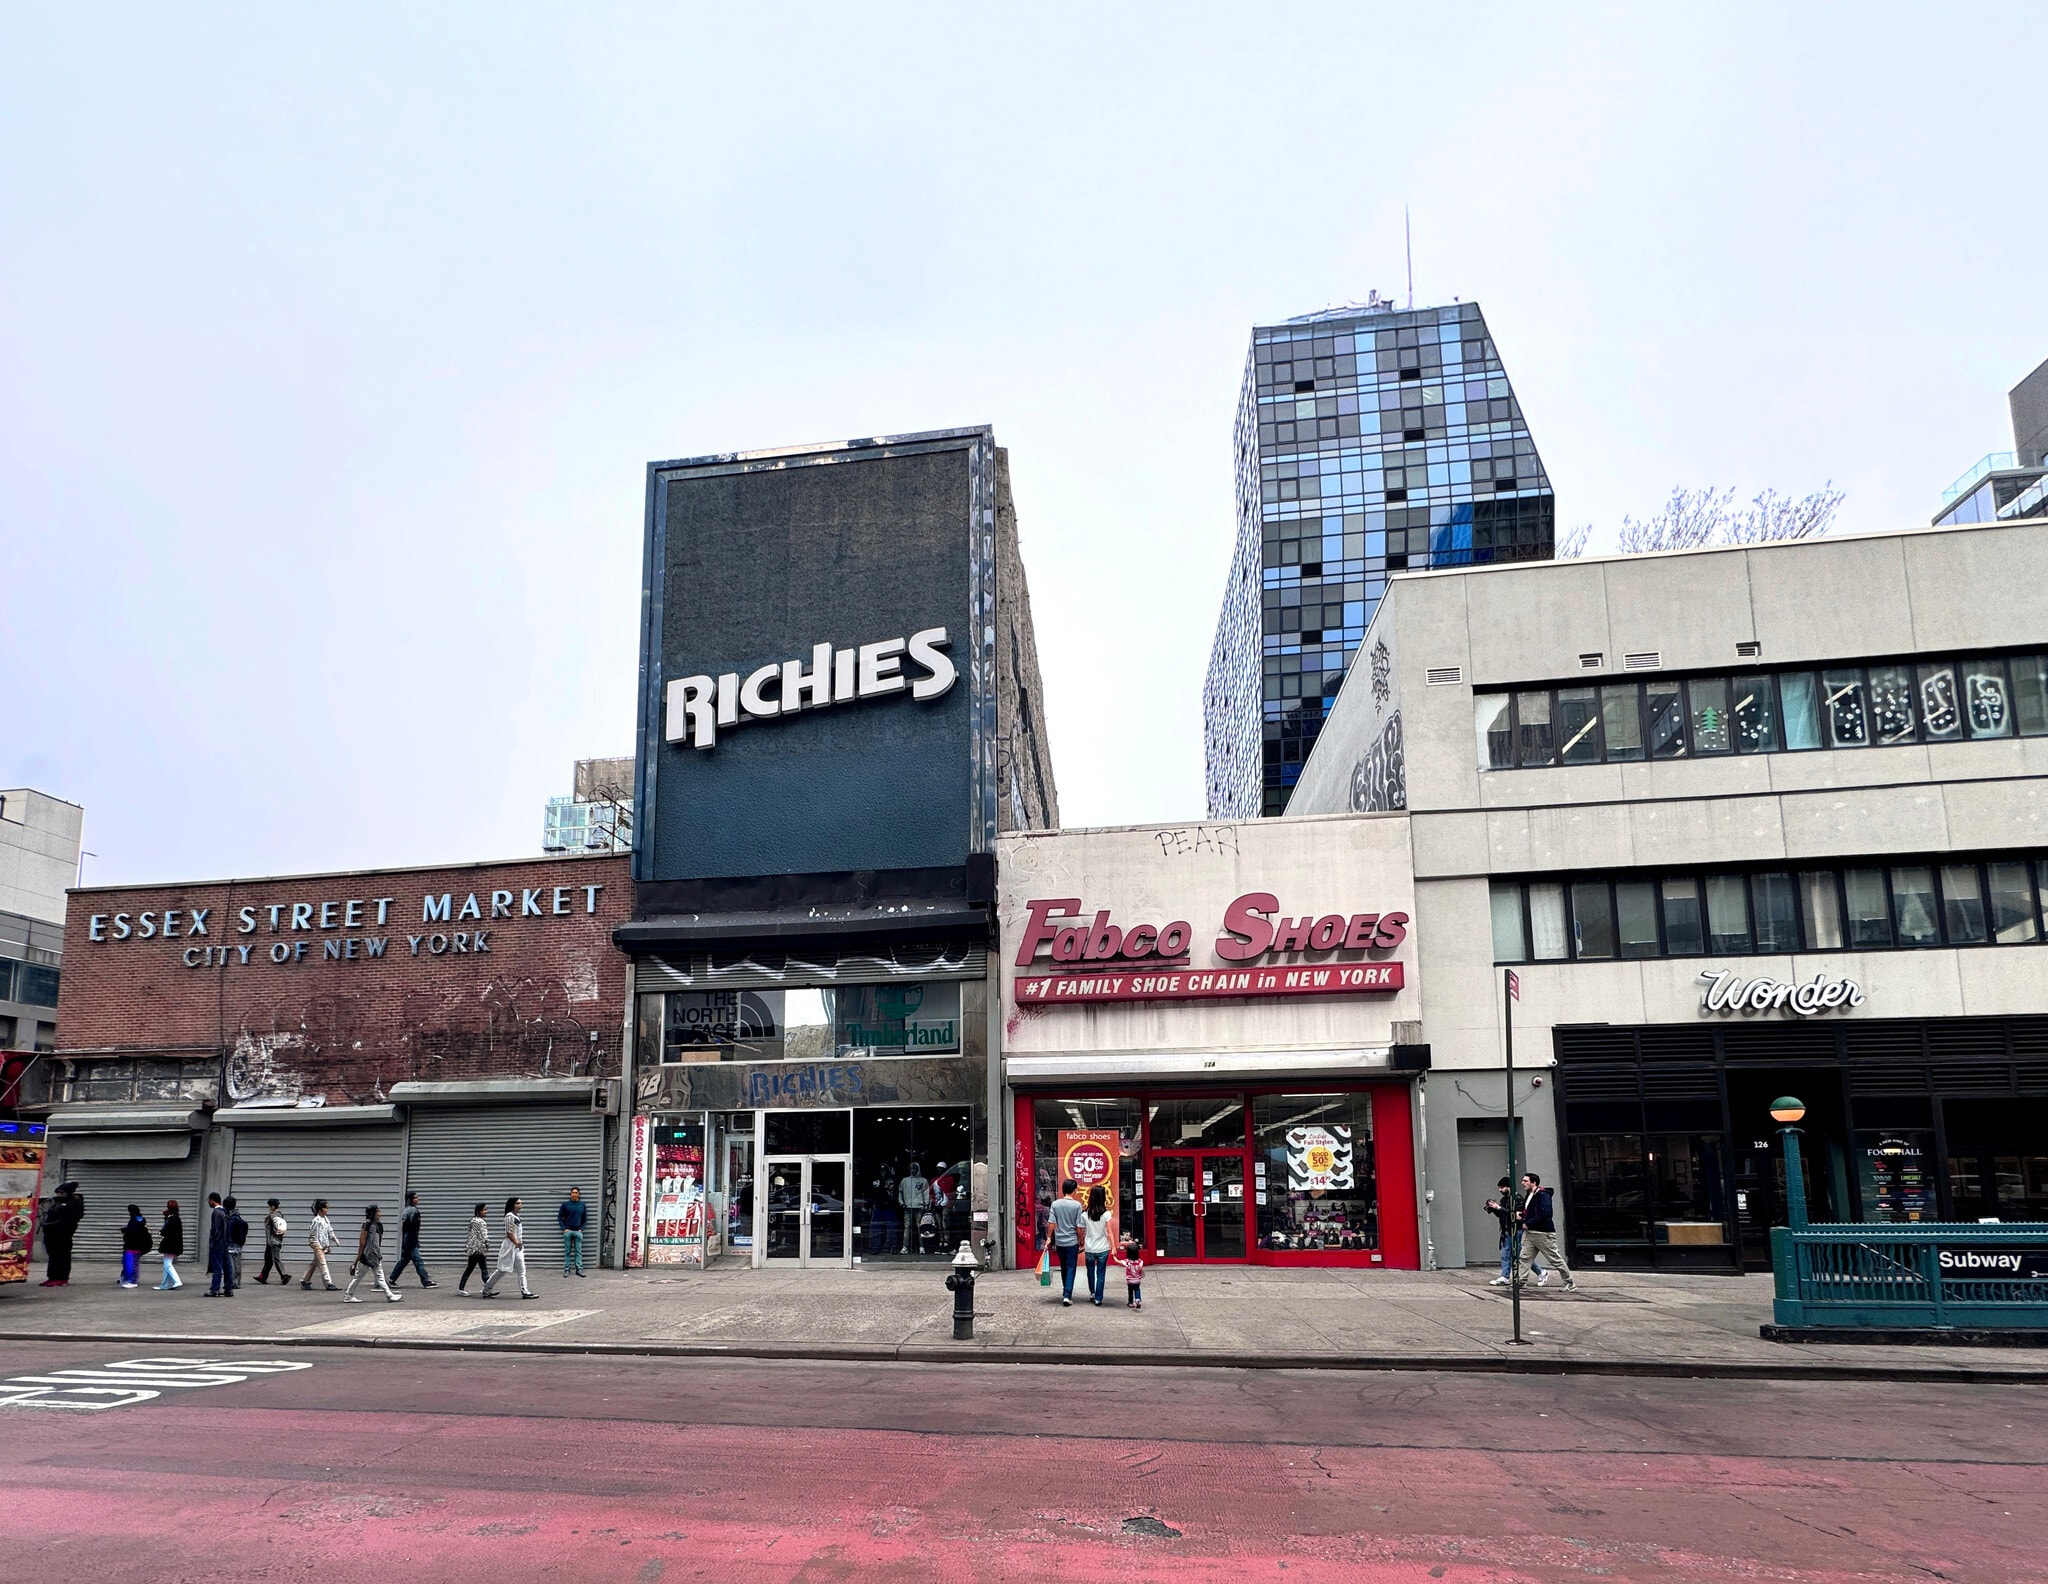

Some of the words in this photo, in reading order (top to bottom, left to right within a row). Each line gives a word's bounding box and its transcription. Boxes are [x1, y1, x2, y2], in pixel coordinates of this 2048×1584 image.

[665, 626, 957, 750] RICHIES
[89, 908, 209, 941] ESSEX
[238, 898, 394, 934] STREET
[423, 885, 604, 922] MARKET
[1015, 898, 1192, 967] Fabco
[1215, 892, 1410, 961] SHOES
[183, 944, 255, 967] CITY
[270, 941, 309, 964] OF
[323, 937, 389, 960] NEW
[407, 930, 492, 956] YORK
[1025, 978, 1052, 998] #1
[1055, 978, 1123, 996] FAMILY
[1131, 976, 1180, 993] SHOE
[1188, 973, 1250, 991] CHAIN
[1257, 972, 1276, 988] in
[1285, 971, 1330, 988] NEW
[1339, 968, 1391, 985] YORK
[1700, 969, 1866, 1015] Wonder
[704, 991, 738, 1006] THE
[673, 1007, 738, 1024] NORTH
[692, 1022, 738, 1038] FACE
[845, 1020, 954, 1047] Timberland
[751, 1065, 863, 1102] RICHIES
[1066, 1132, 1087, 1140] fabco
[1090, 1132, 1111, 1140] shoes
[1939, 1251, 2022, 1272] Subway
